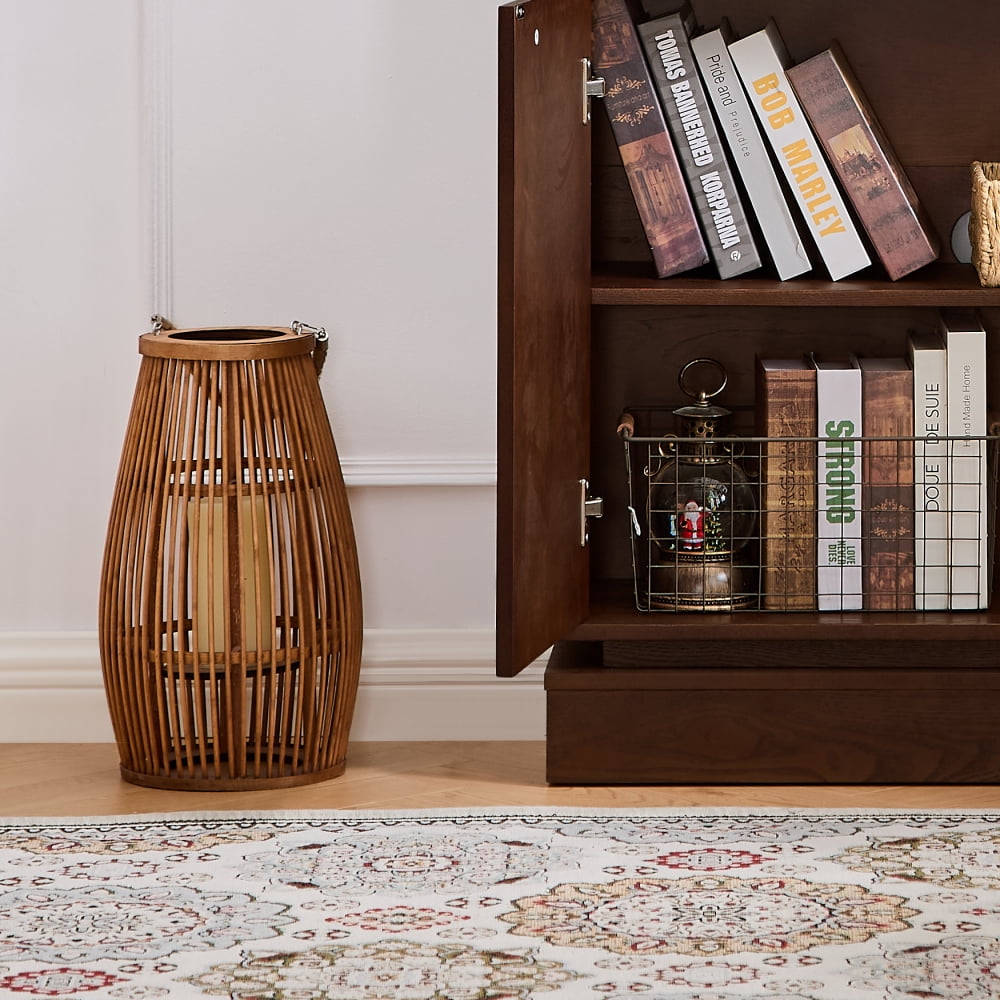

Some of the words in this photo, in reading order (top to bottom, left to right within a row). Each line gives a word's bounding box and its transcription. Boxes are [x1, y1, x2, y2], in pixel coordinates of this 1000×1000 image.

[706, 54, 726, 84] Pride
[718, 82, 735, 107] and
[728, 111, 751, 158] Prejudice
[654, 29, 686, 81] TOMAS
[671, 80, 714, 168] BANNERHED
[700, 170, 741, 250] KORPARNA
[752, 72, 795, 130] BOB
[781, 138, 846, 238] MARLEY
[962, 364, 971, 392] Home
[925, 383, 939, 418] SUIE
[962, 395, 971, 420] Made
[925, 423, 939, 446] DE
[825, 420, 856, 524] STRONG
[846, 545, 856, 565] LOVE
